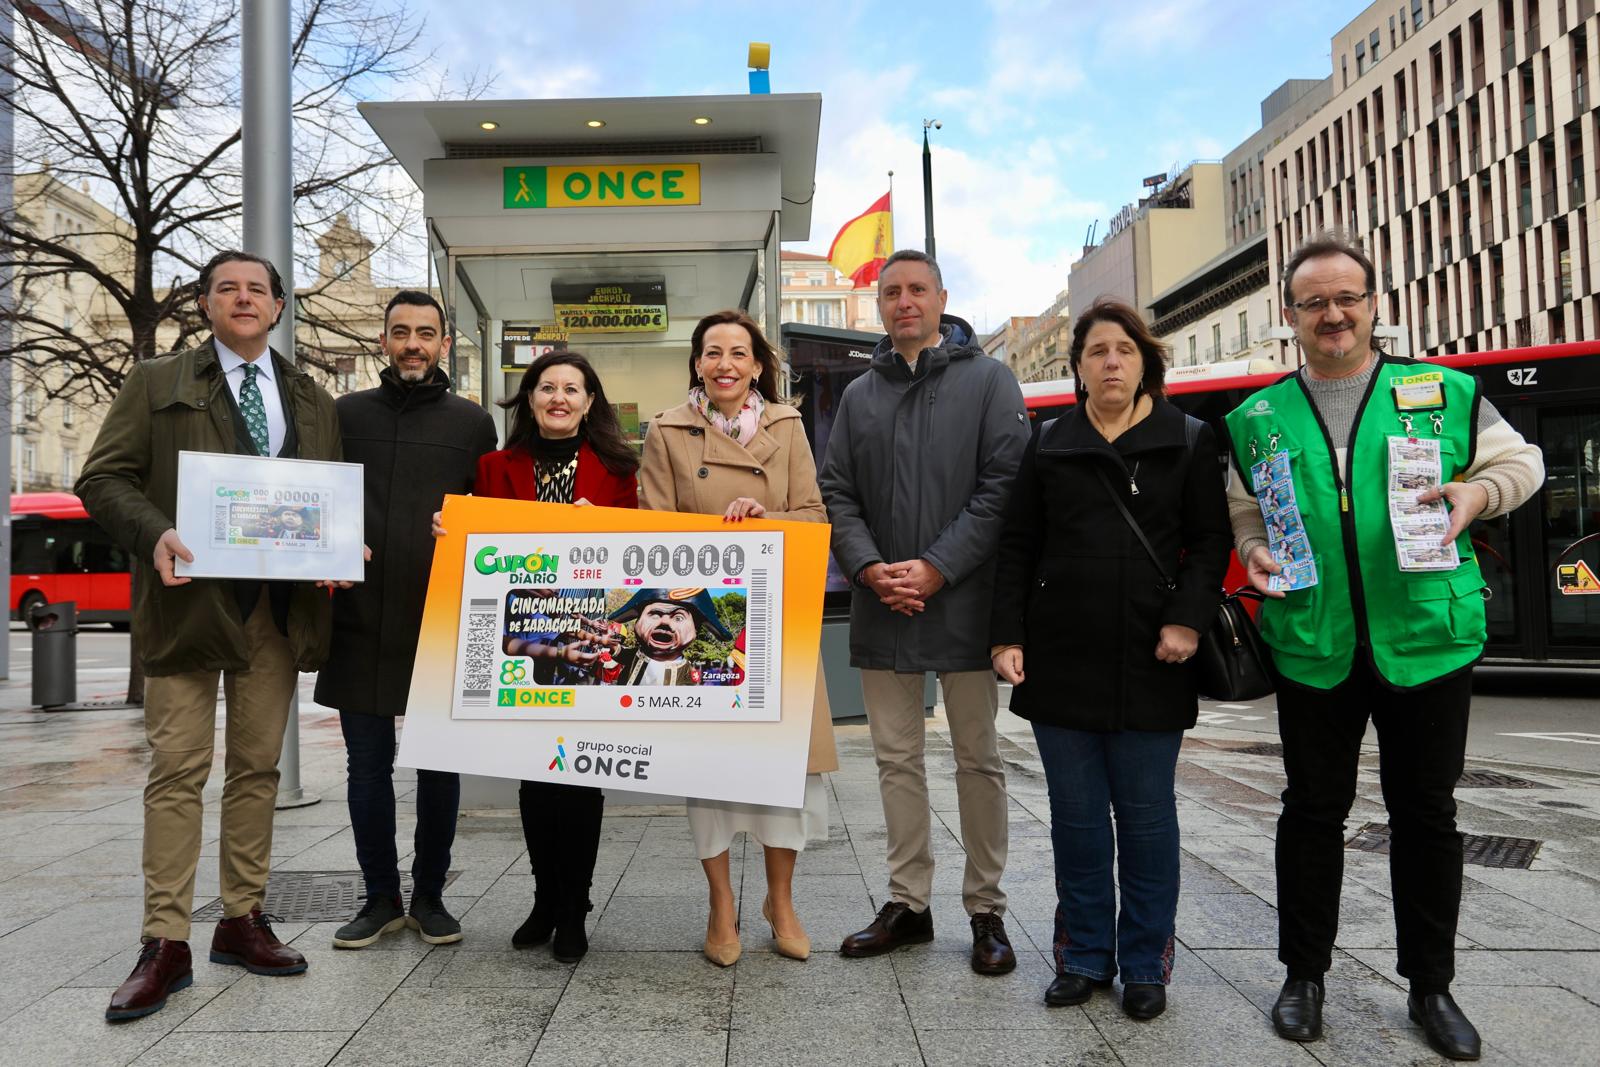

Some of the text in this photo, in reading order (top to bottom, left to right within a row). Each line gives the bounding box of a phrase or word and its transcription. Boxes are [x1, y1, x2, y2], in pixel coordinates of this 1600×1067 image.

[563, 170, 684, 200] ONCE
[563, 314, 662, 328] 120.000.000 €
[848, 350, 873, 359] JCDecau
[1406, 373, 1440, 385] ONCE
[274, 490, 320, 503] 00000
[474, 546, 559, 575] CUPÓN
[569, 546, 609, 565] 000
[622, 544, 745, 577] 00000
[573, 569, 602, 579] SERIE
[510, 596, 606, 615] CINCOMARZADA
[509, 617, 581, 633] DE ZARAGOZA
[500, 659, 526, 685] 85
[702, 671, 740, 681] Zaragoza
[520, 691, 571, 705] ONCE
[637, 696, 702, 708] 5 MAR. 24
[576, 741, 653, 756] grupo social
[574, 754, 650, 781] ONCE
